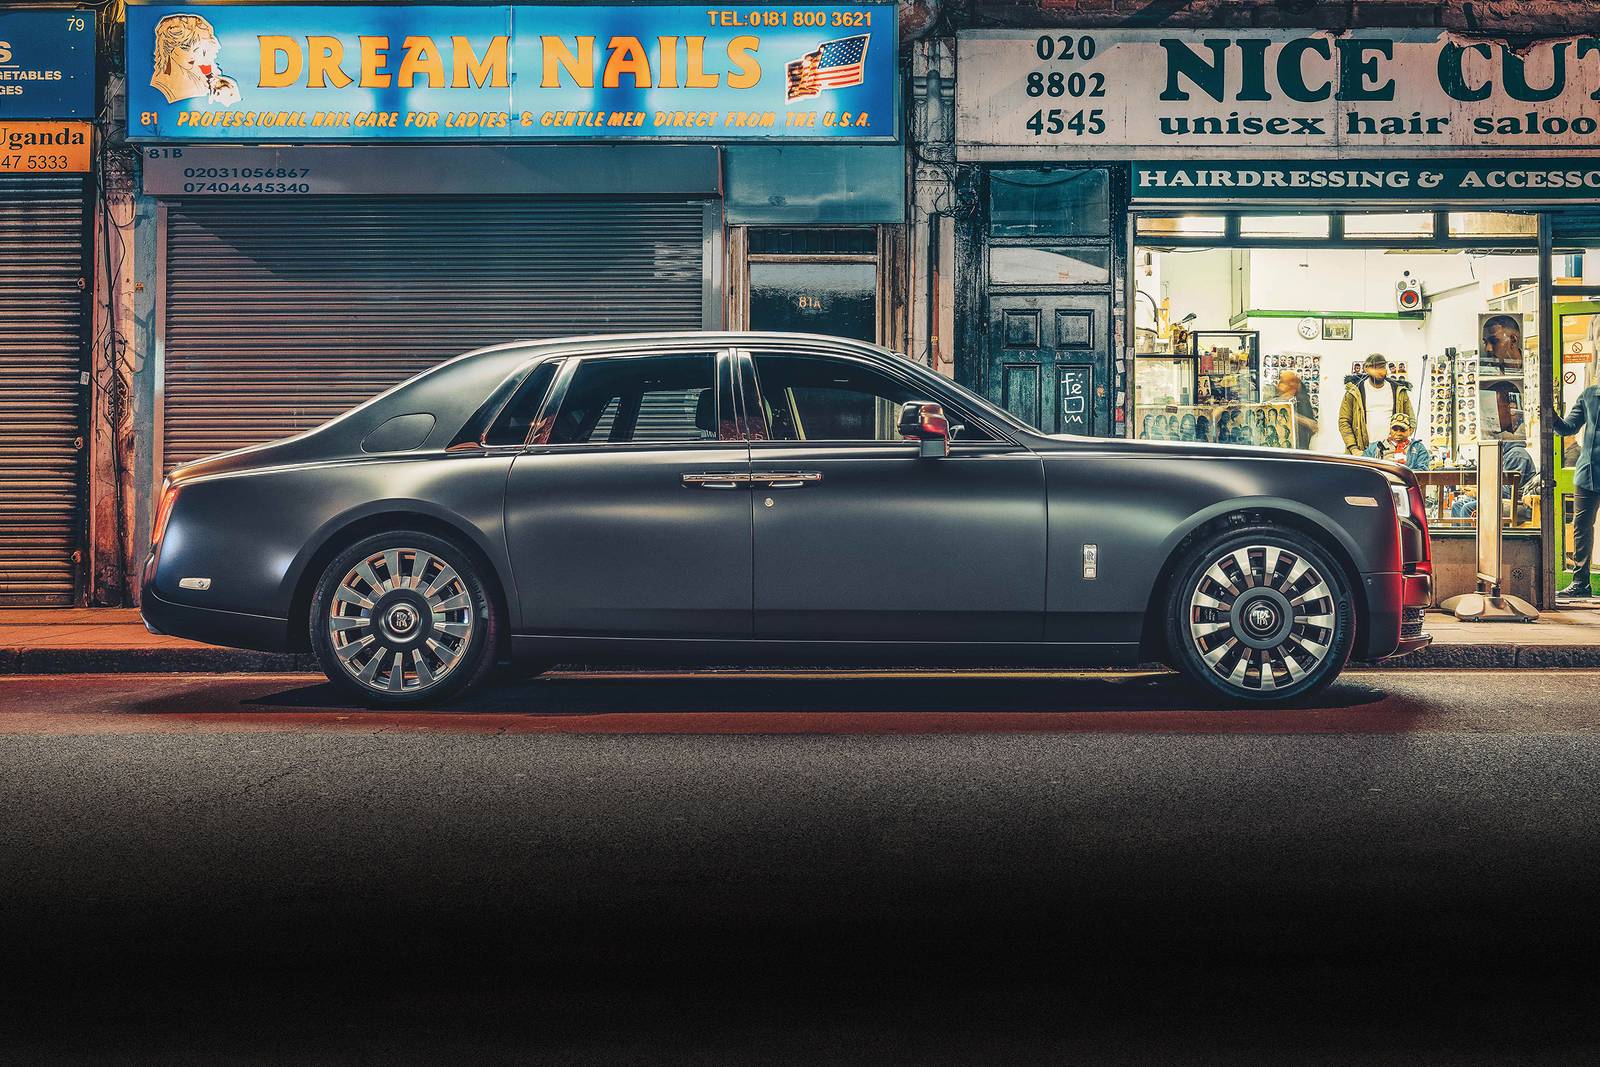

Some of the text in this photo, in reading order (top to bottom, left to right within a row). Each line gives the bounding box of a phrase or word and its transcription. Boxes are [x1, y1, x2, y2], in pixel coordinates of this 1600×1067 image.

[66, 18, 85, 32] 79
[792, 11, 827, 27] 800
[831, 11, 872, 27] 3621
[1036, 35, 1096, 61] 020
[256, 35, 762, 89] DREAM NAILS
[1159, 37, 1396, 103] NICE
[1026, 71, 1106, 97] 8802
[140, 111, 159, 126] 81
[176, 111, 307, 128] PROFESSIONAL
[311, 111, 351, 128] NAIL
[354, 111, 400, 128] CARE
[404, 111, 439, 128] FOR
[445, 111, 509, 128] LADIES
[520, 111, 533, 128] &
[653, 111, 719, 128] DIRECT
[724, 111, 776, 128] FROM
[784, 111, 817, 128] THE
[822, 111, 871, 128] U.S.A.
[1026, 108, 1106, 136] 4545
[1159, 111, 1598, 135] unisex hair saloo
[149, 148, 183, 159] 81B
[1, 155, 68, 170] 47 5333
[183, 167, 310, 178] 02031056867
[1139, 170, 1410, 188] HAIRDRESSING
[1417, 170, 1444, 188] &
[183, 182, 310, 193] 07404645340
